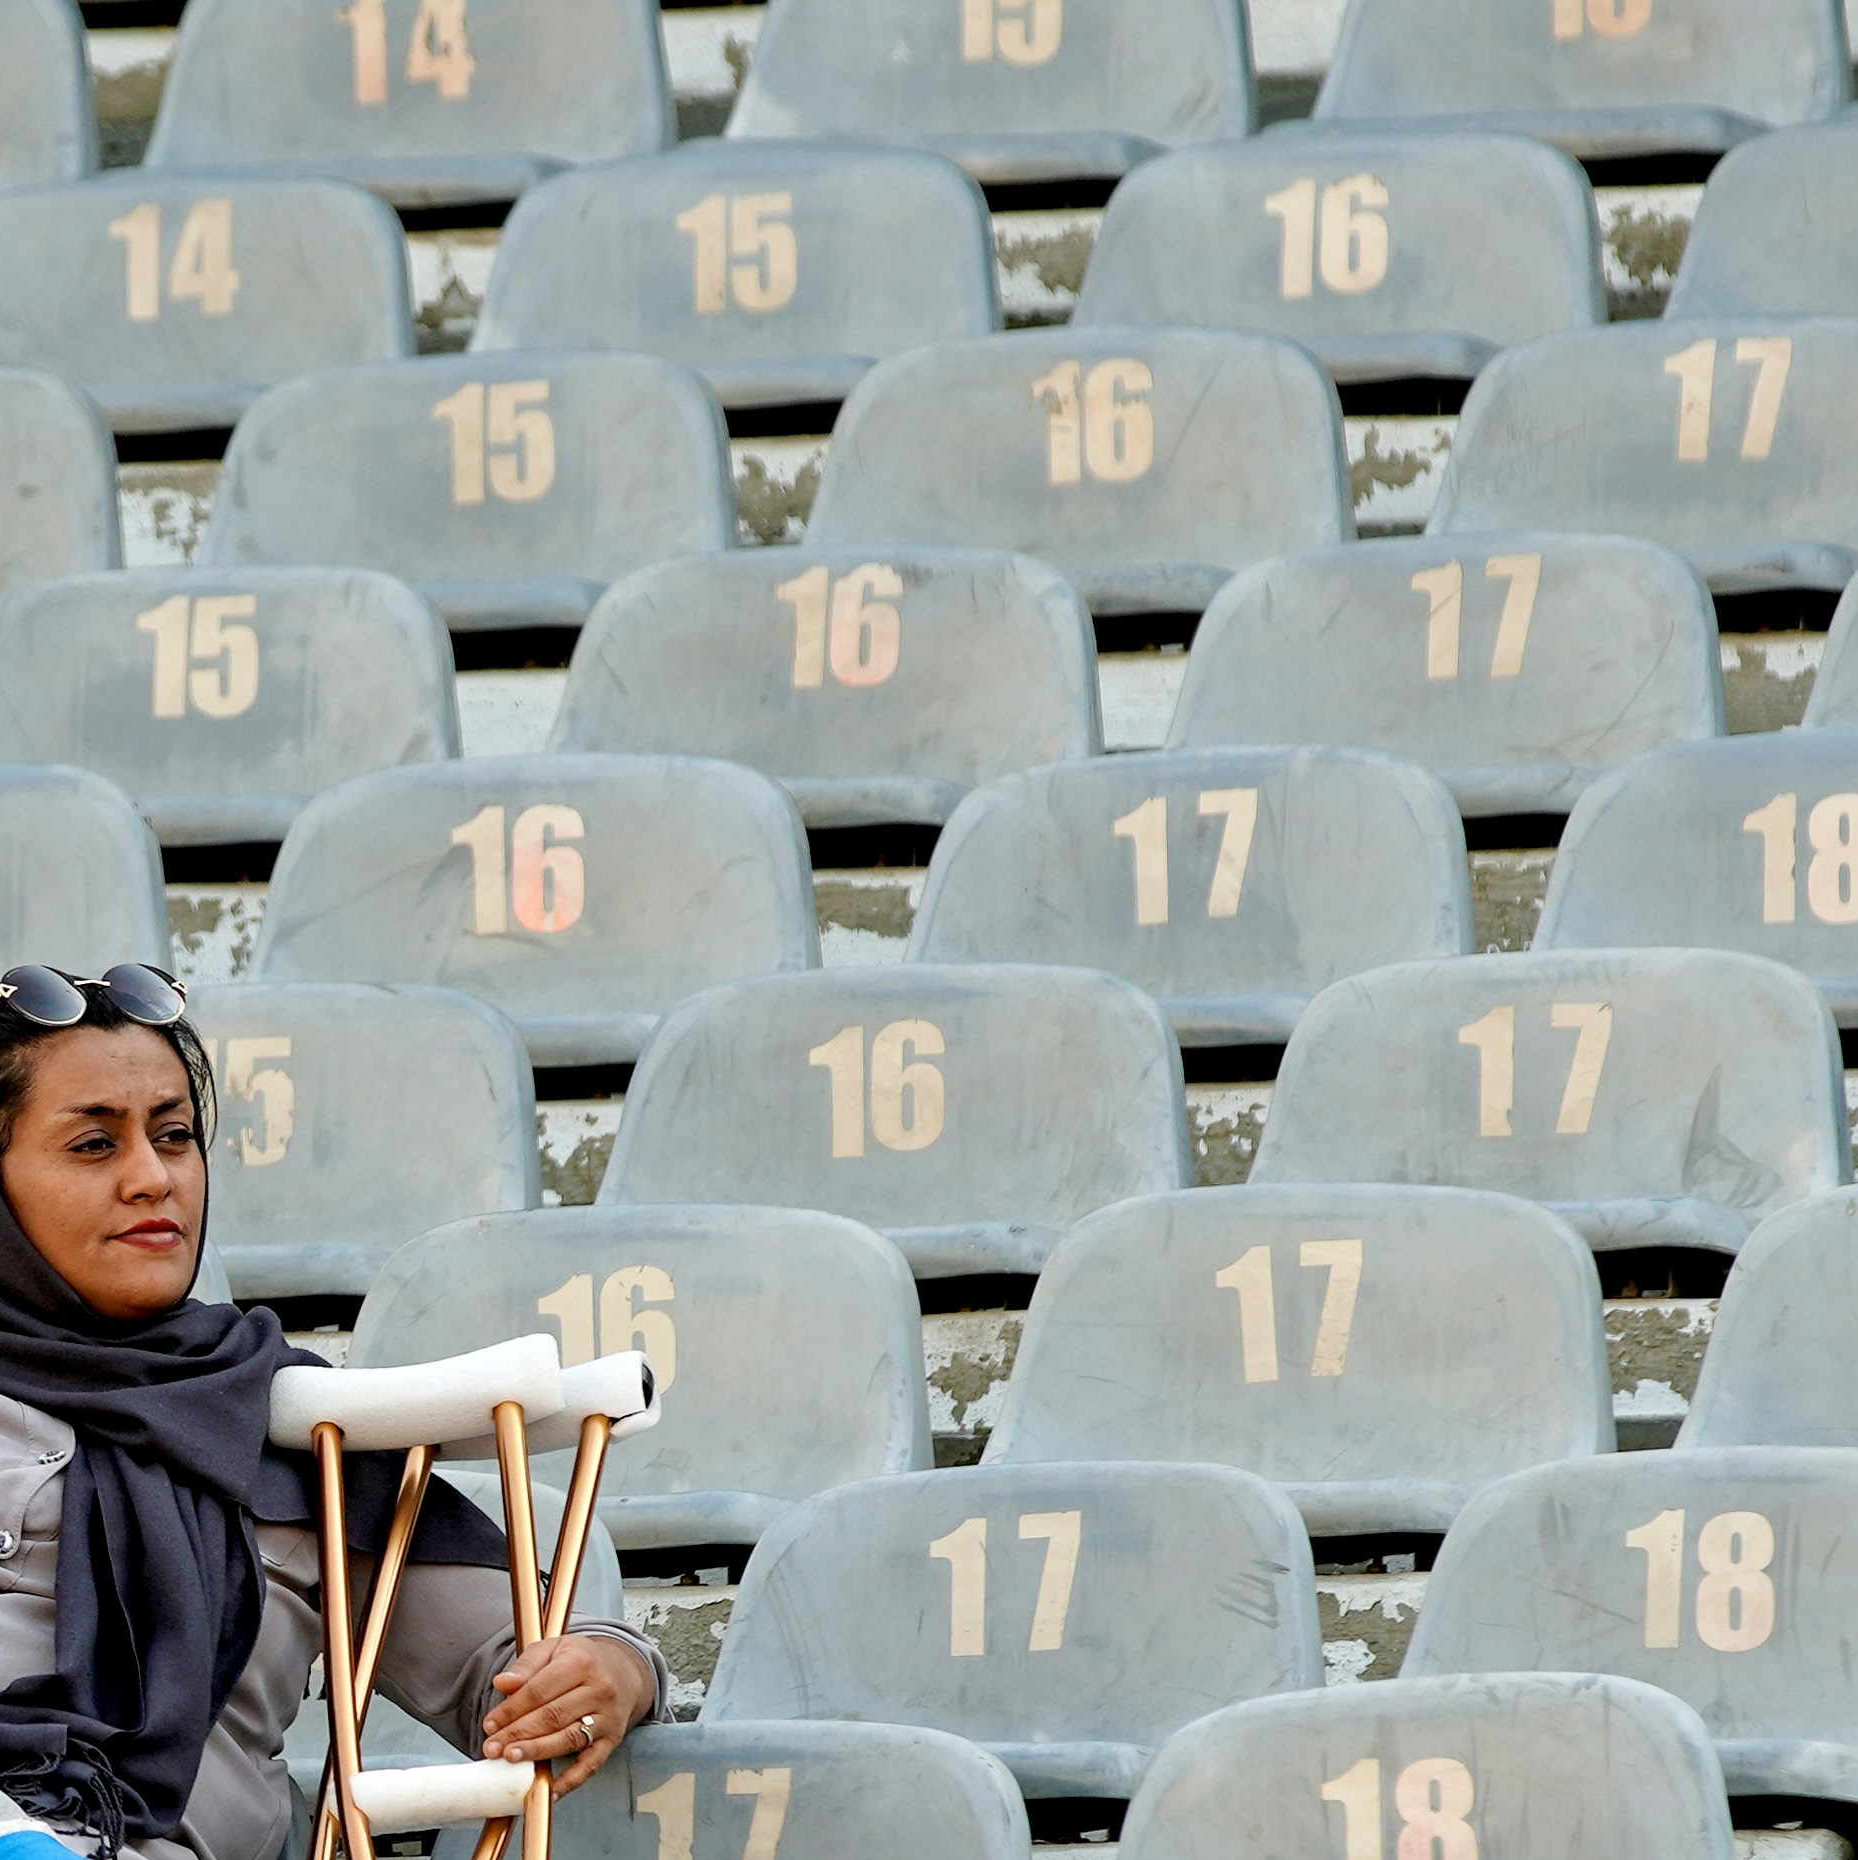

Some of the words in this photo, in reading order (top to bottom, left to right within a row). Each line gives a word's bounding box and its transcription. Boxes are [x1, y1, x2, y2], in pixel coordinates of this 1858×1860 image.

[338, 0, 475, 104] 14
[110, 199, 241, 320] 14
[677, 193, 797, 314] 15
[1264, 174, 1390, 299] 16
[433, 381, 555, 506] 15
[1029, 360, 1155, 485] 16
[1664, 339, 1792, 462] 17
[136, 596, 259, 718] 15
[775, 567, 903, 690] 16
[1411, 555, 1541, 679] 17
[452, 805, 586, 939] 16
[1113, 789, 1258, 926] 17
[1743, 793, 1858, 923] 18
[202, 1036, 295, 1166] 5
[808, 1019, 945, 1158] 16
[1459, 1003, 1613, 1138] 17
[537, 1265, 677, 1397] 16
[1216, 1240, 1362, 1383] 17
[929, 1511, 1081, 1656] 17
[1627, 1510, 1776, 1652] 18
